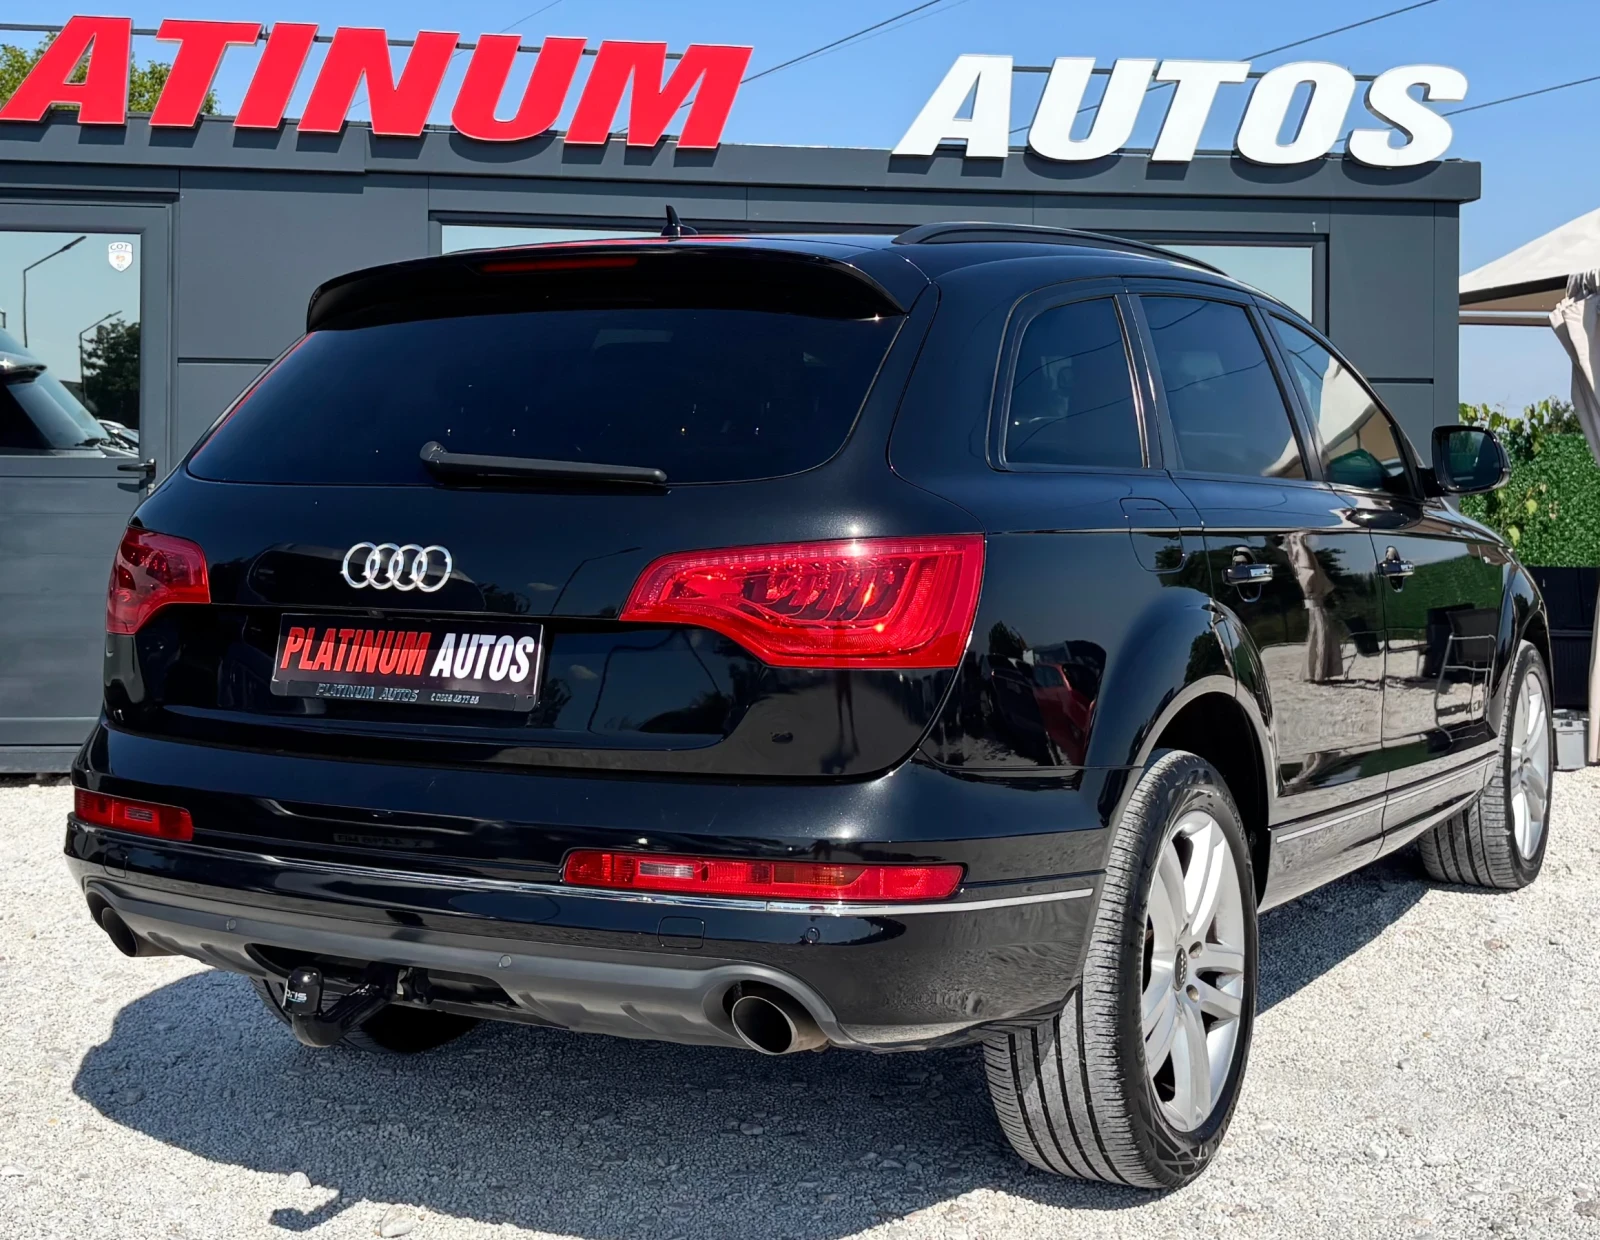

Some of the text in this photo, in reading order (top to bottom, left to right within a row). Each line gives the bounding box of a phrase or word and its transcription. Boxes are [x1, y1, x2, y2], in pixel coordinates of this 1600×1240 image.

[0, 16, 1468, 167] ATINUM AUTOS
[280, 626, 535, 683] PLATINUM AUTOS
[315, 683, 375, 700] PLATINUM
[378, 687, 421, 703] AUTOS
